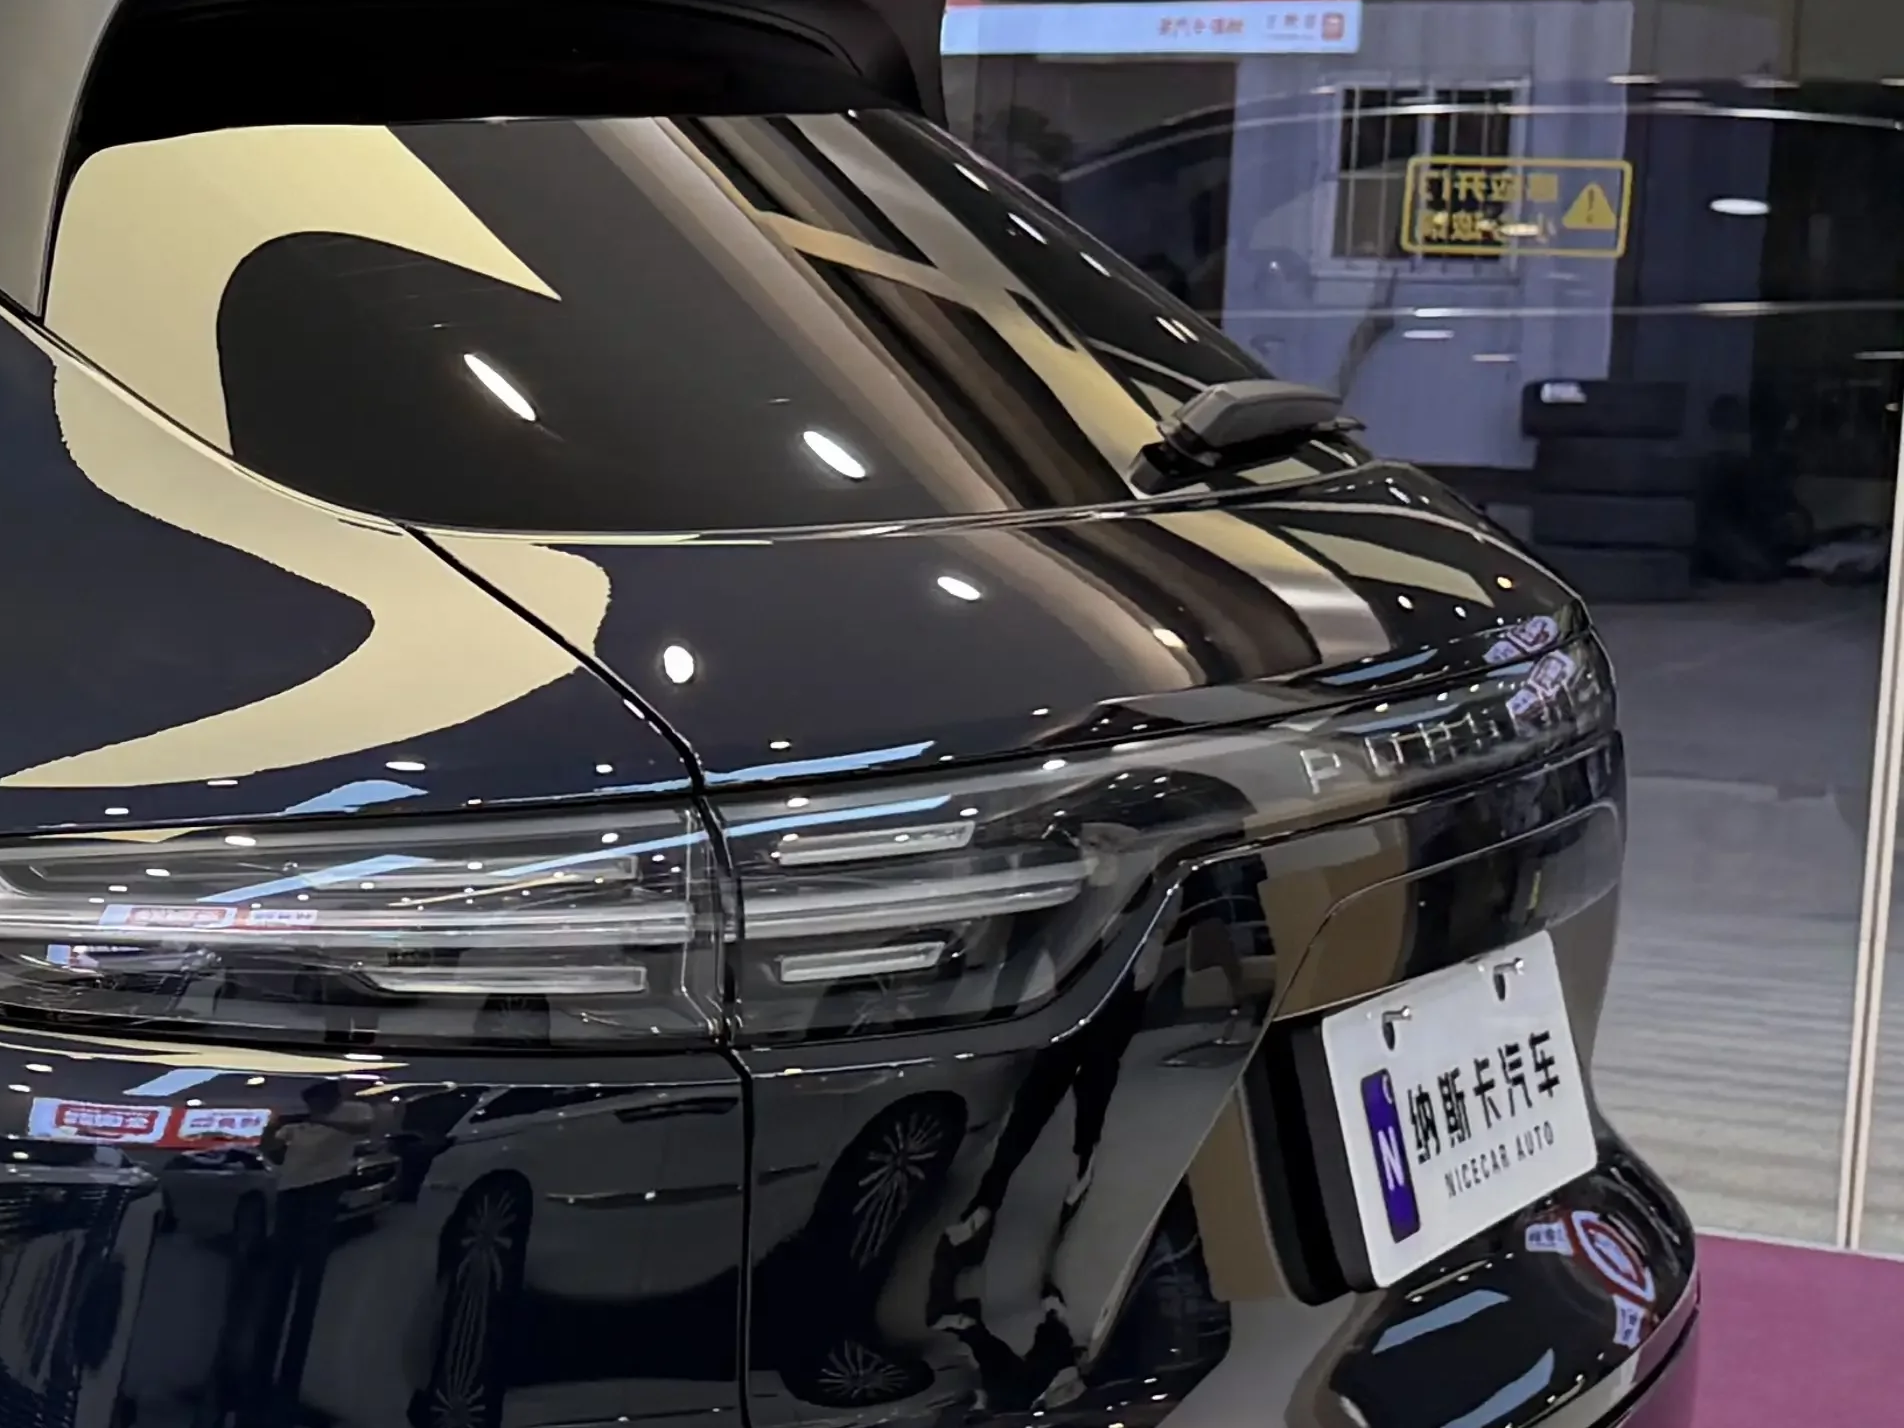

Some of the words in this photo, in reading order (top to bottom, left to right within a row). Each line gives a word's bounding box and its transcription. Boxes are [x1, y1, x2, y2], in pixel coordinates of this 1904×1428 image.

[1407, 1031, 1560, 1165] 纳斯卡汽车
[1377, 1126, 1405, 1191] N
[1444, 1144, 1510, 1198] NICECAR
[1515, 1121, 1554, 1162] AUTO
